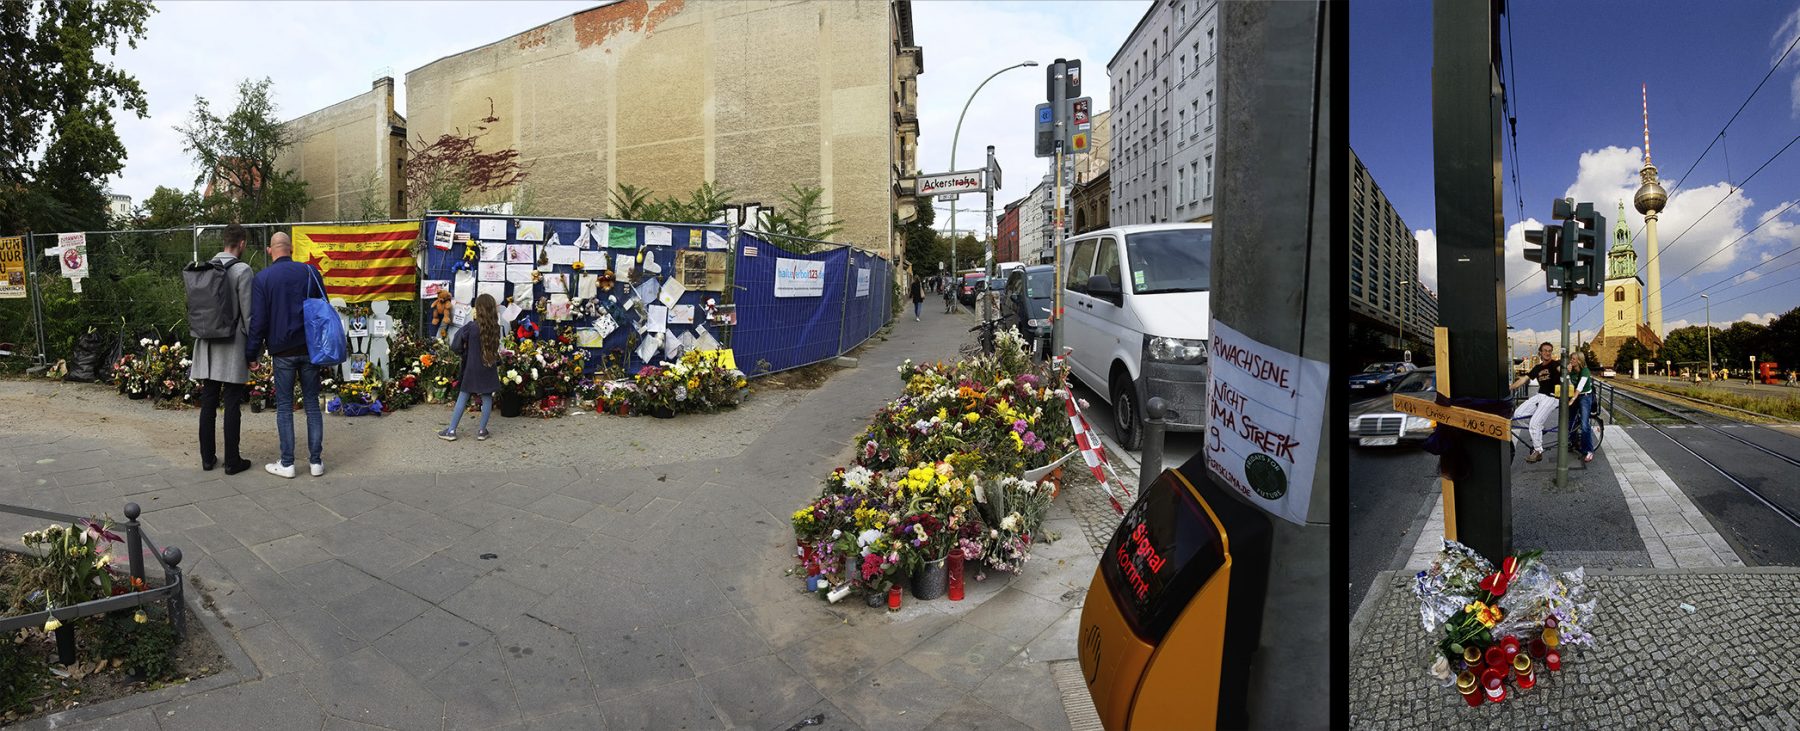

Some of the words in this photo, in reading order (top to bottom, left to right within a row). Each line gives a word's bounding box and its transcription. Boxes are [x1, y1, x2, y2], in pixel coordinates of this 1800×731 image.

[1266, 457, 1281, 472] FOR
[1256, 487, 1283, 499] FUTURE
[1132, 523, 1167, 573] Signal
[1117, 543, 1149, 599] kommt
